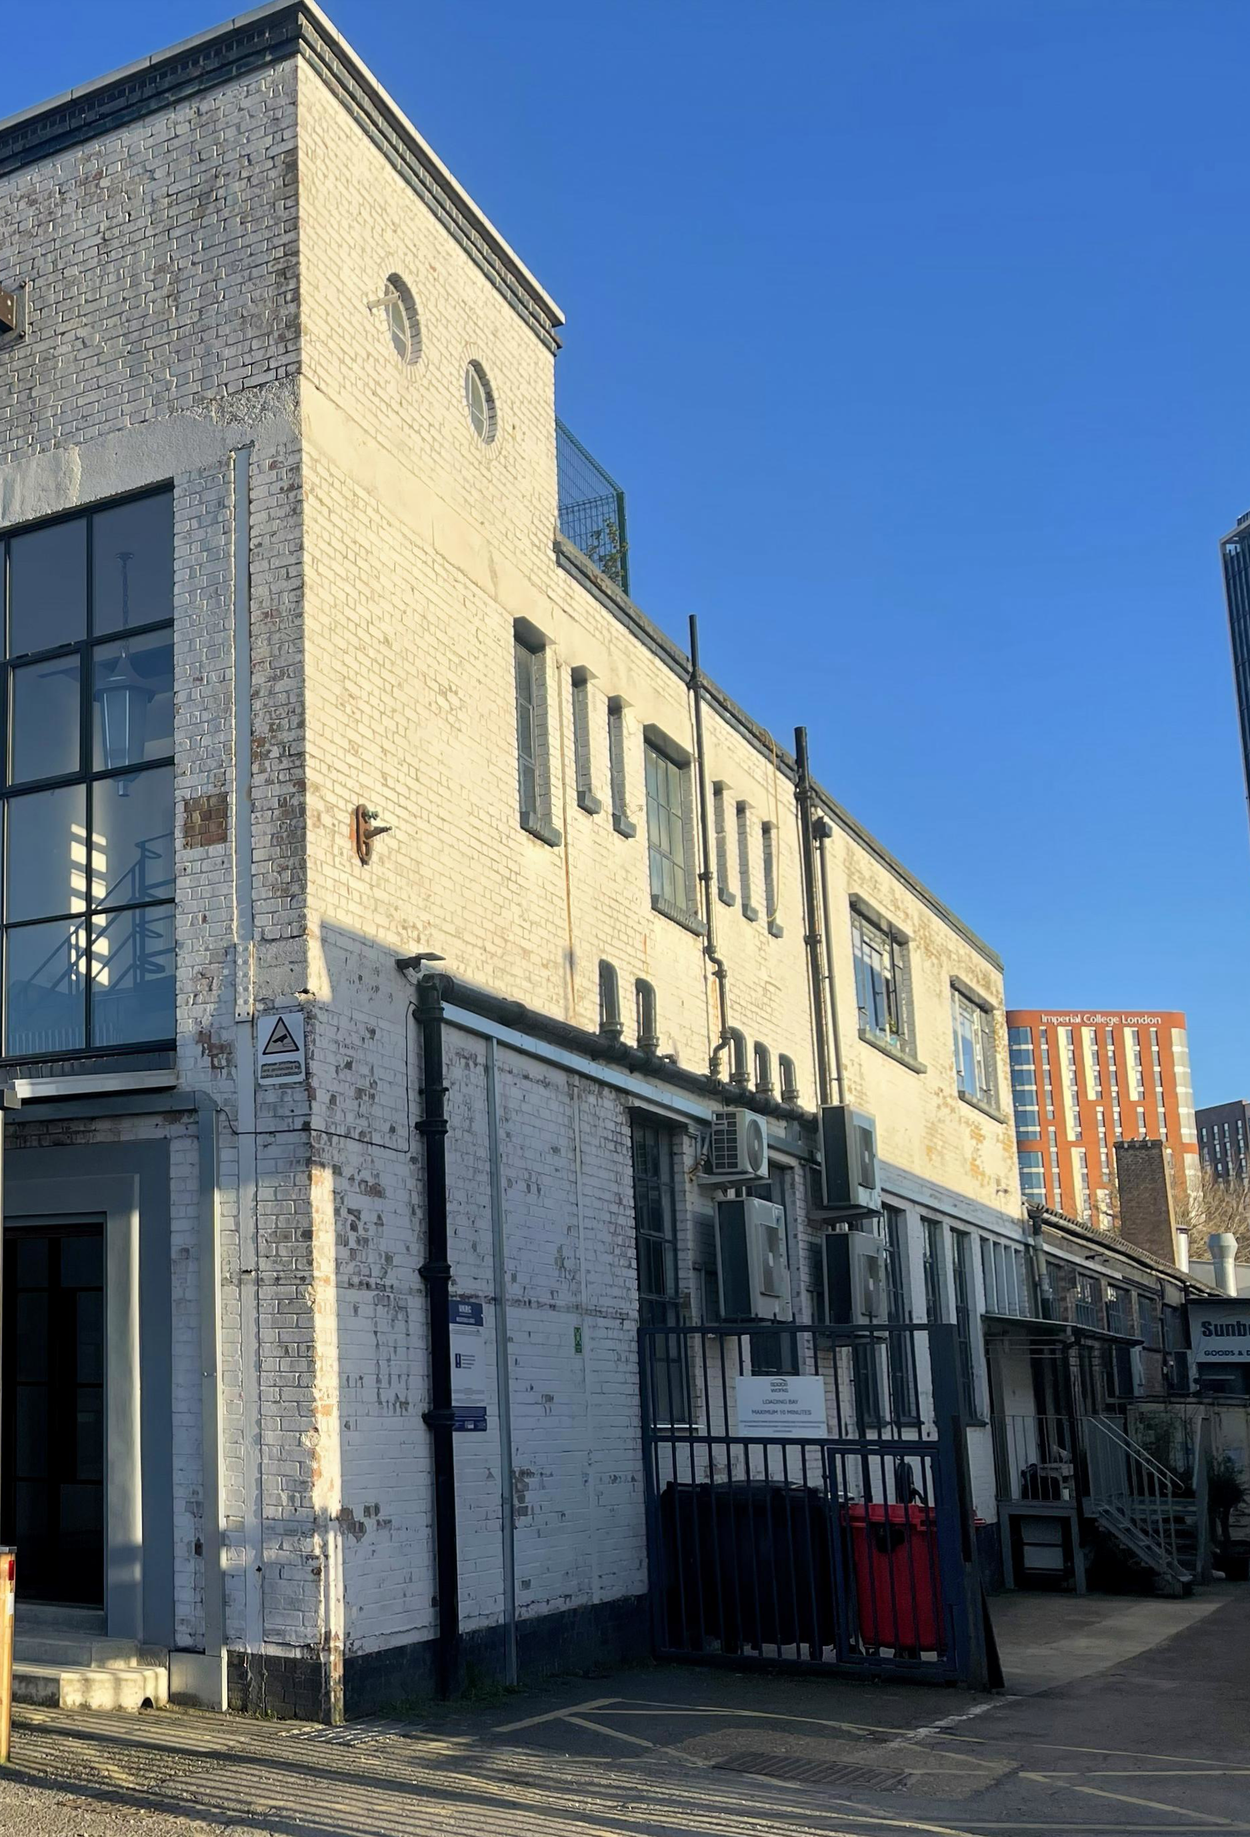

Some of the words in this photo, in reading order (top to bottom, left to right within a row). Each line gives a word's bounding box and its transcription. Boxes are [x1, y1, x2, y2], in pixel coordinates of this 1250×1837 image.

[1041, 1014, 1081, 1026] Imperial
[1083, 1014, 1119, 1026] College
[1121, 1015, 1161, 1024] London
